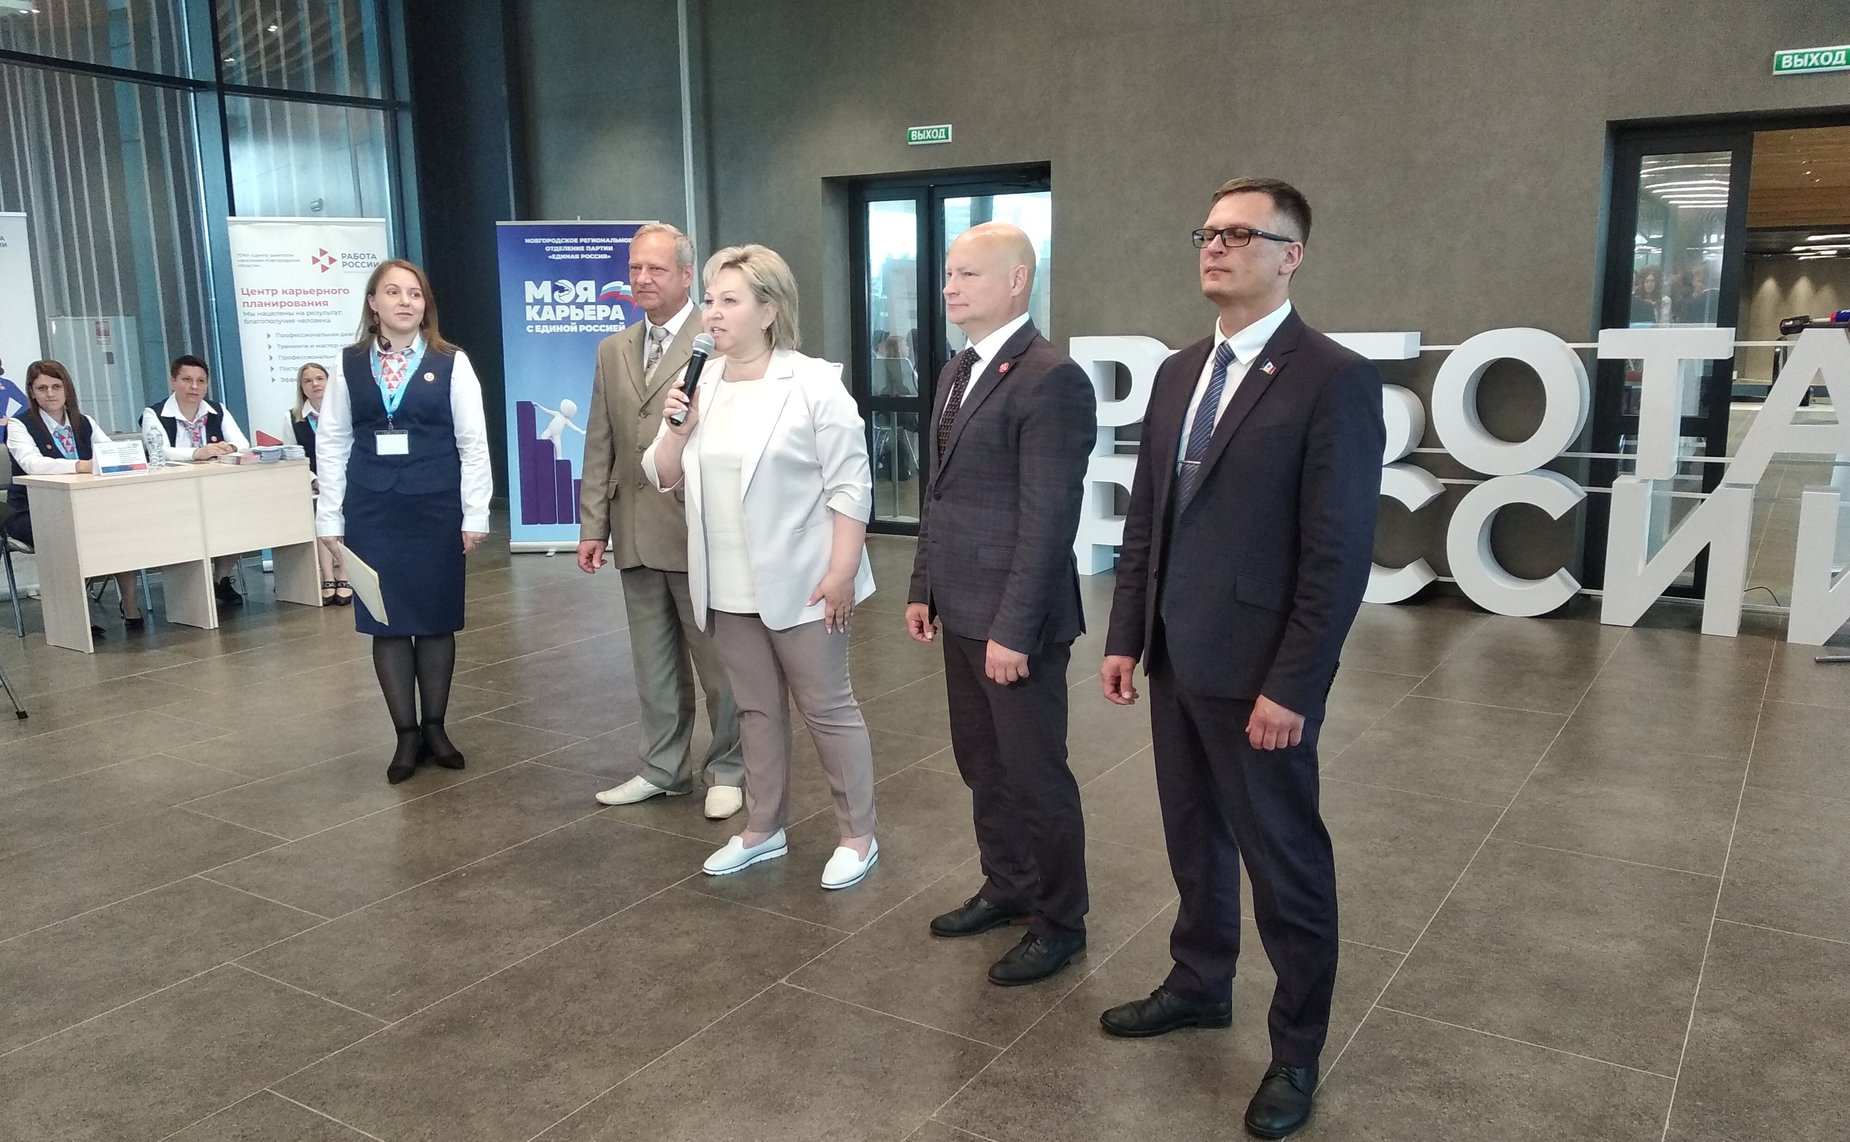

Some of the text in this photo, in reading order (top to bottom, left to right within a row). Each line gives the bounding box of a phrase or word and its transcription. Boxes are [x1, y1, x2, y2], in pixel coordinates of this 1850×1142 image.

[1782, 50, 1846, 69] ВЫХОД
[911, 128, 946, 141] ВЫХОД
[341, 252, 377, 260] РАБОТА
[241, 287, 350, 297] Центр карьерного
[242, 300, 329, 309] планирования
[525, 305, 625, 321] КАРЬЕРА
[526, 322, 626, 334] С ЕДИНОЙ РОССИЕЙ
